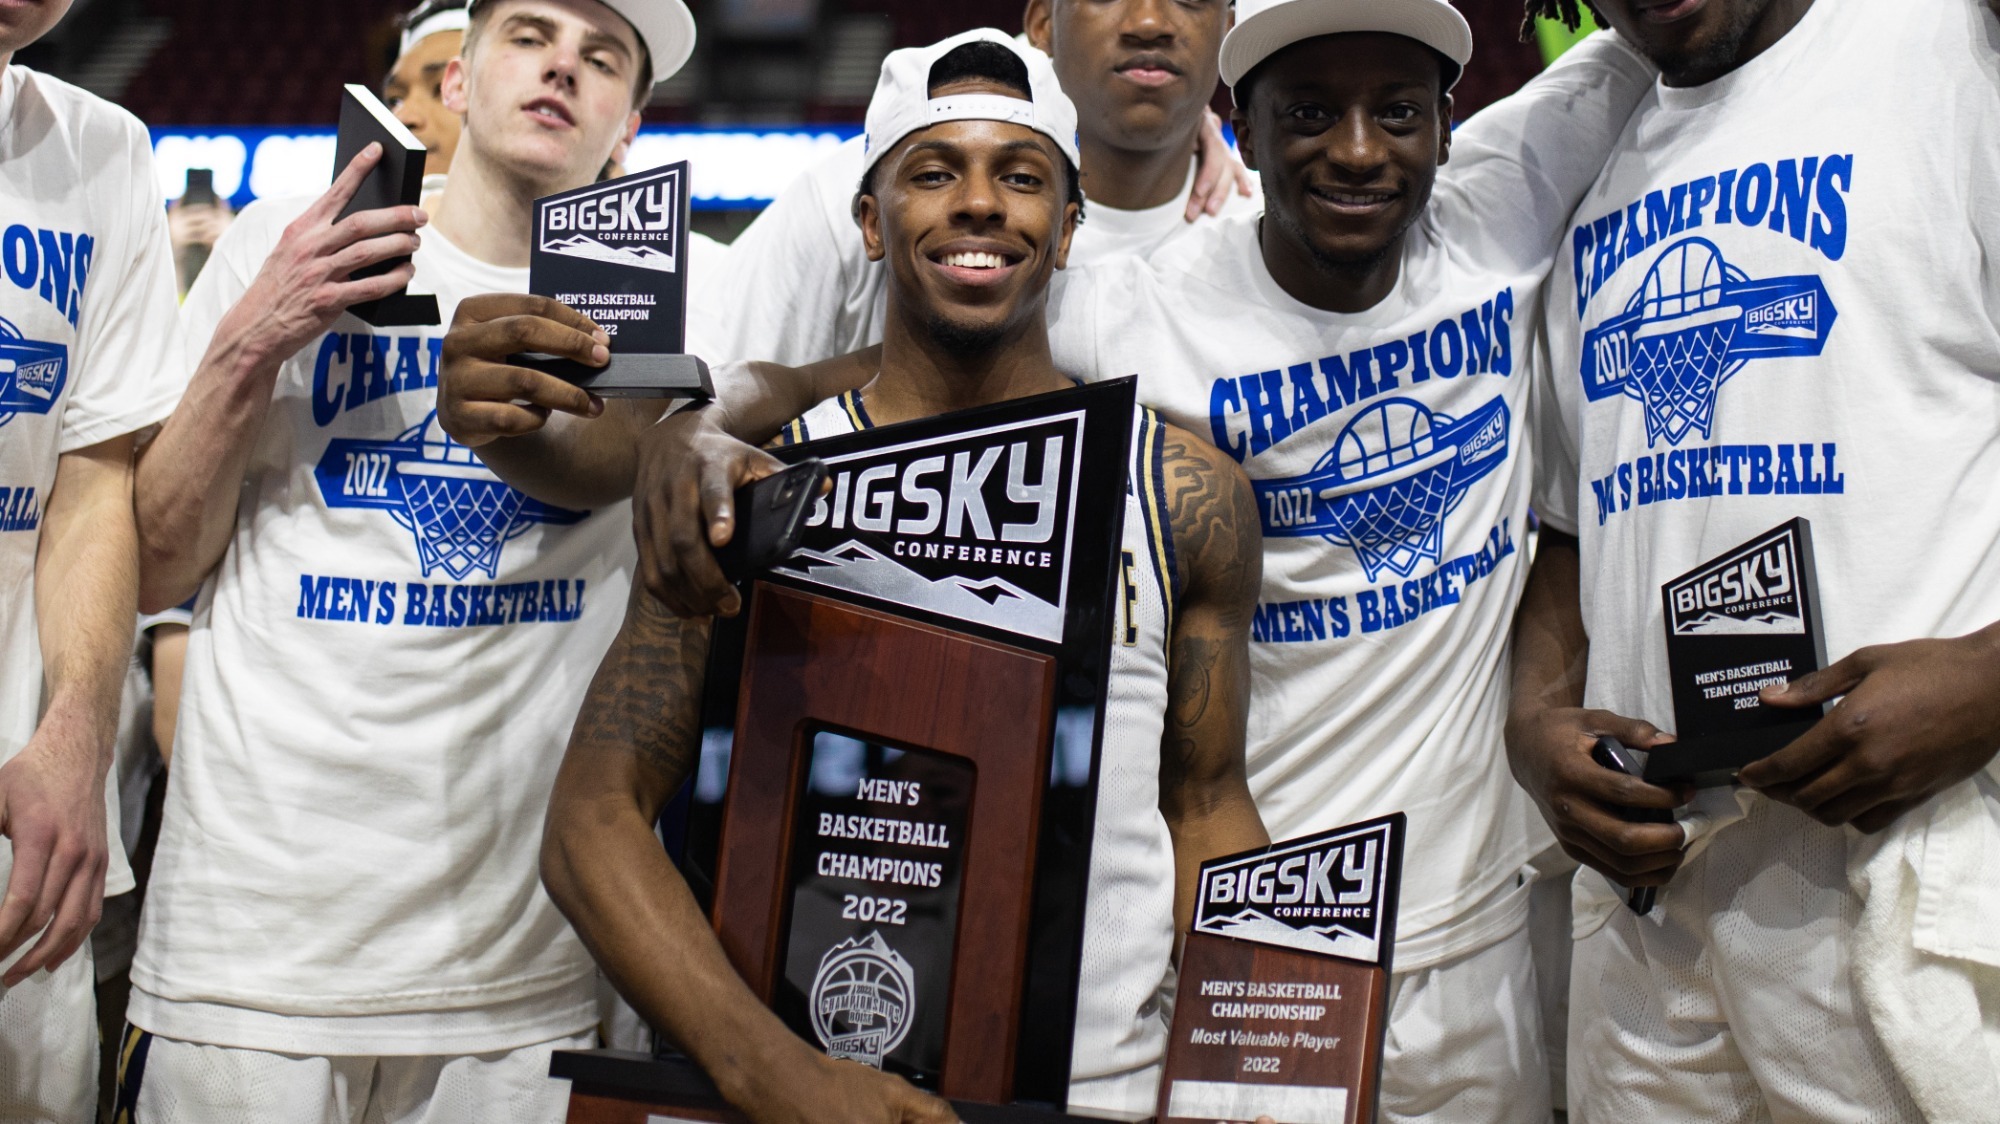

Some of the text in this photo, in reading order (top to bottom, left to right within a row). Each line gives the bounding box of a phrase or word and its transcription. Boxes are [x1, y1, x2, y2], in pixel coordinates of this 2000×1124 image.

[598, 233, 669, 241] CONFERENCE
[1572, 154, 1853, 322] CHAMPIONS
[555, 293, 656, 305] MEN'S BASKETBALL
[592, 309, 650, 320] CHAMPION
[1209, 286, 1514, 464] CHAMPIONS
[343, 453, 390, 497] 2022
[1636, 442, 1844, 506] BASKETBALL
[1264, 486, 1317, 528] 2022
[894, 541, 1052, 568] CONFERENCE
[297, 574, 586, 628] MEN'S BASKETBALL
[1725, 595, 1793, 615] CONFERENCE
[1252, 595, 1351, 643] MEN'S
[1695, 659, 1792, 685] MEN'S BASKETBALL
[1703, 676, 1788, 699] TEAM CHAMPION
[1734, 696, 1760, 710] 2022
[856, 777, 920, 806] MEN'S
[818, 812, 950, 848] BASKETBALL
[817, 851, 942, 888] CHAMPIONS
[842, 894, 907, 925] 2022
[1273, 906, 1371, 918] CONFERENCE
[1200, 980, 1342, 1000] MEN'S BASKETBALL
[1212, 1002, 1327, 1021] CHAMPIONSHIP
[1190, 1028, 1341, 1053] Most Valuable Player
[1242, 1056, 1280, 1073] 2022
